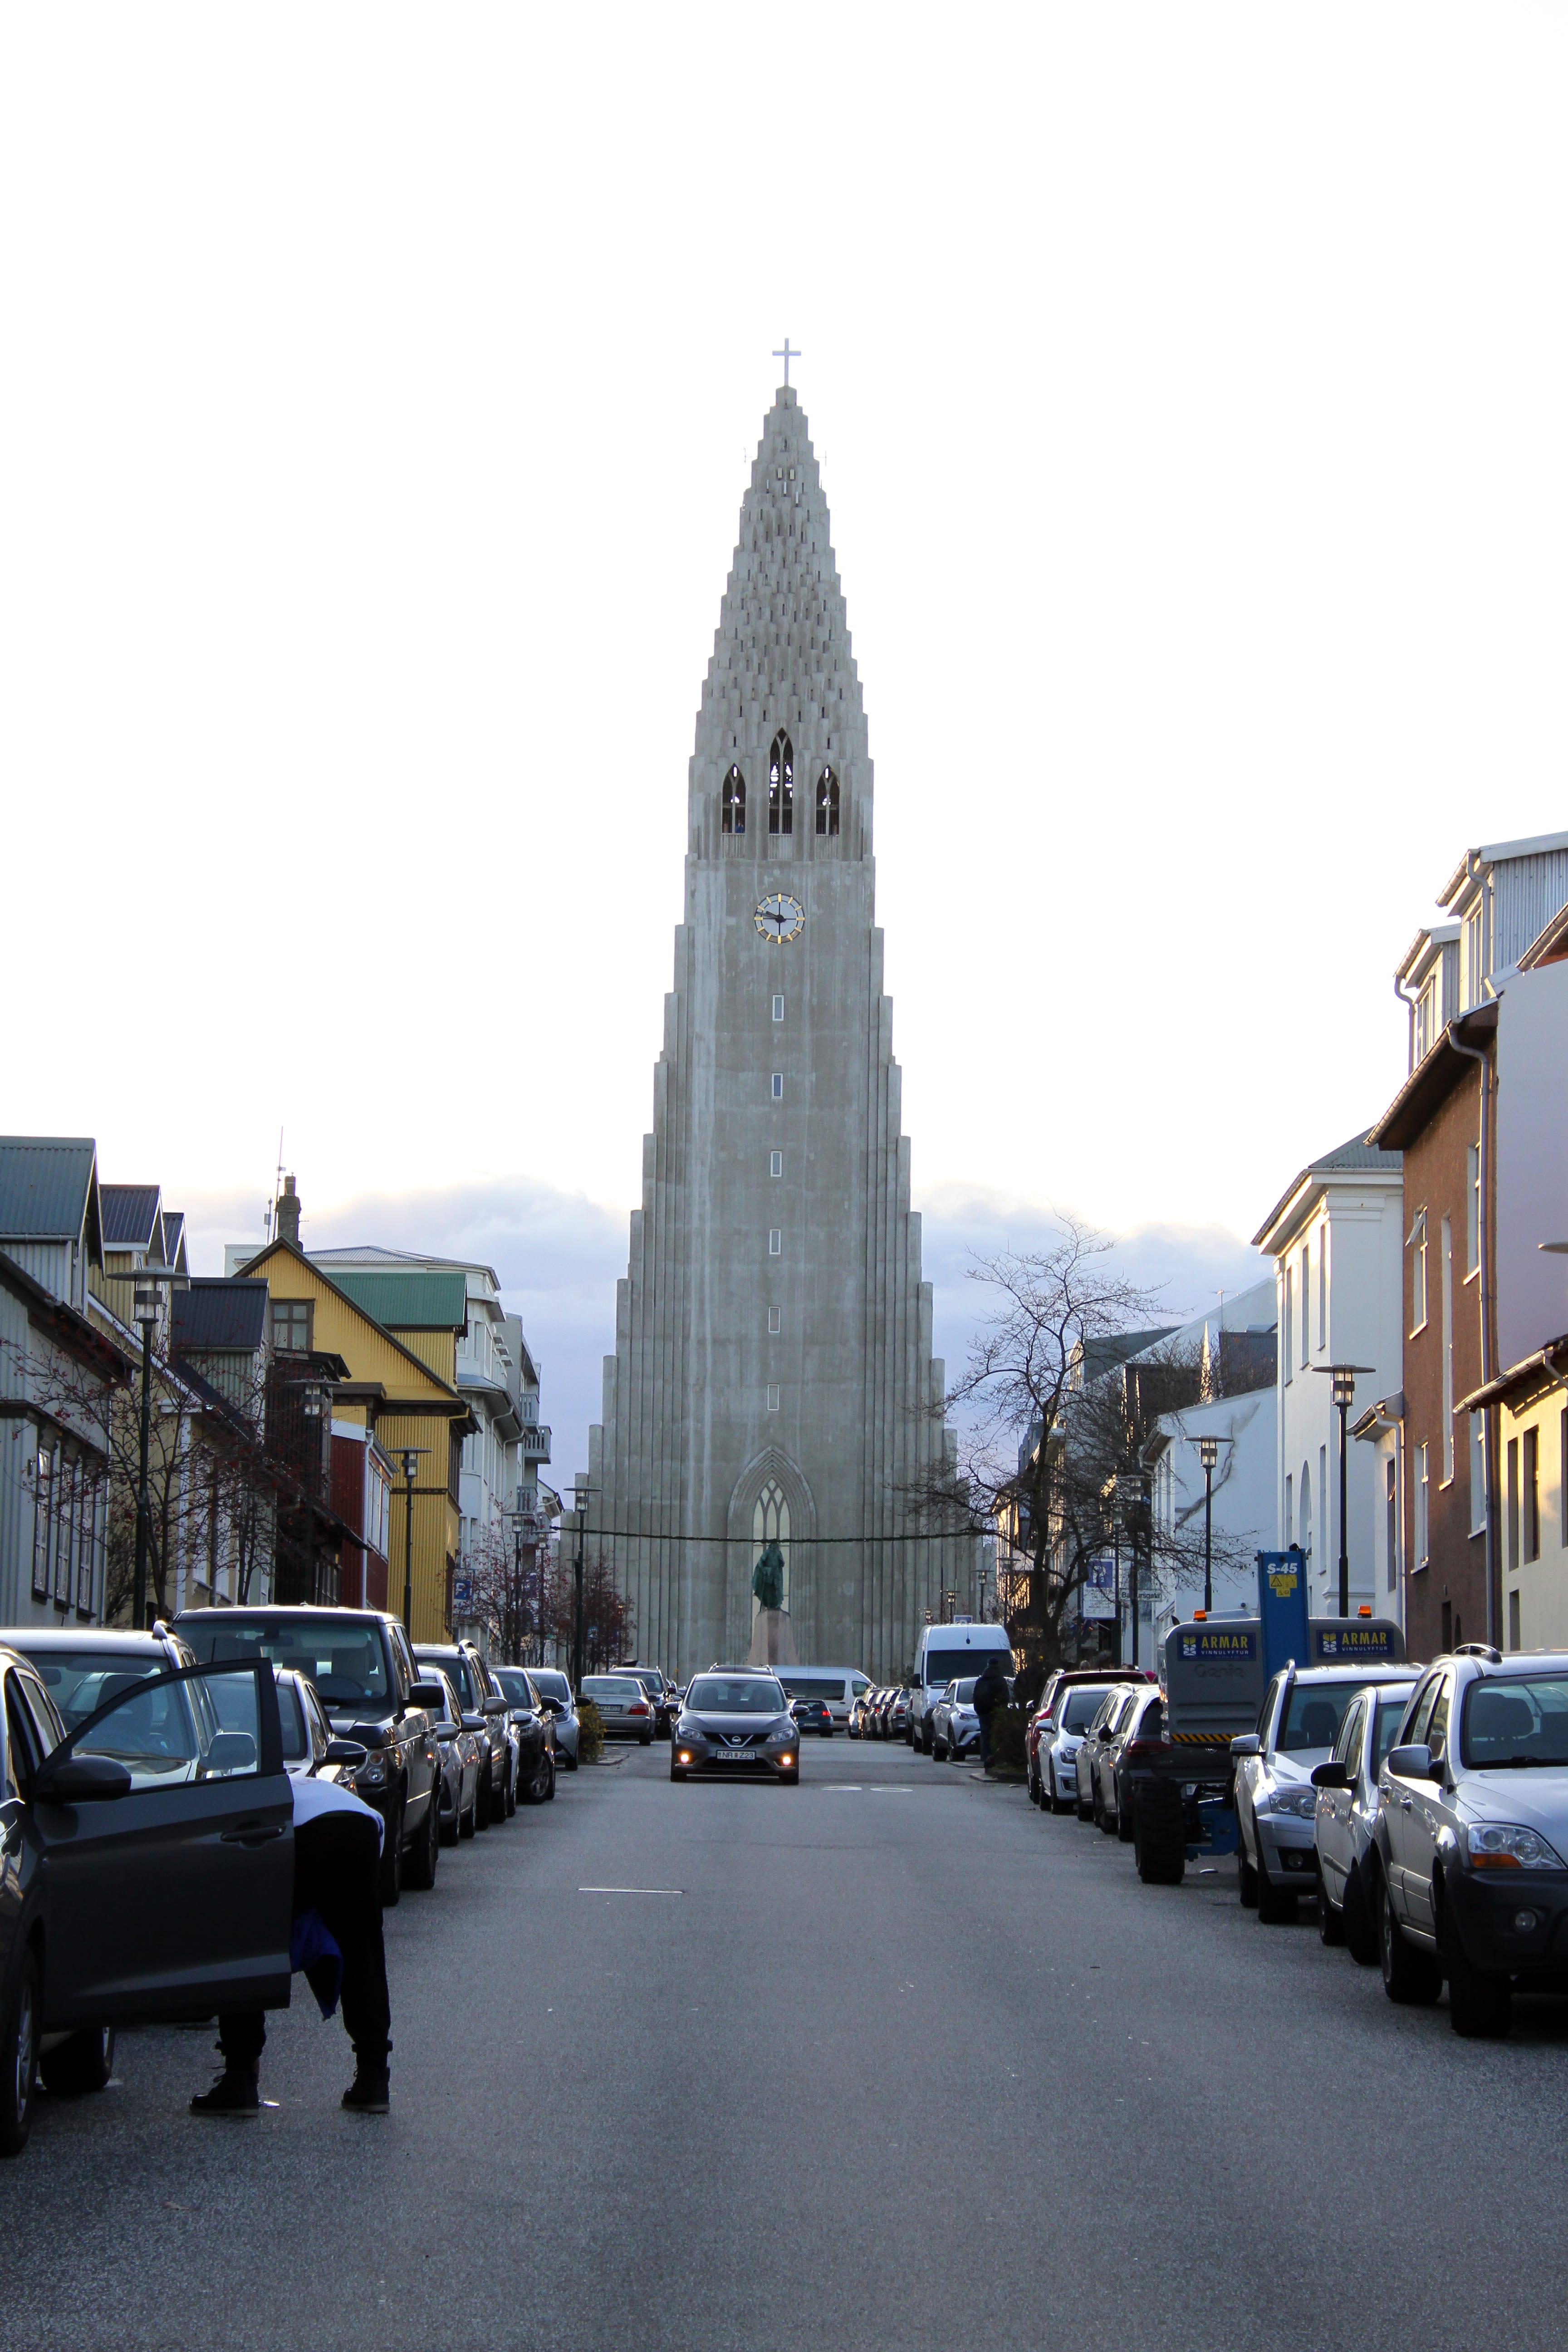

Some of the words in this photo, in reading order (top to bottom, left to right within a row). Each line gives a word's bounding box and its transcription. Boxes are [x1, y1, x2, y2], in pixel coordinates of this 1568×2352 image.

[1267, 1563, 1298, 1574] S-45
[1201, 1636, 1248, 1648] ARMAR
[1342, 1632, 1387, 1645] ARMAR
